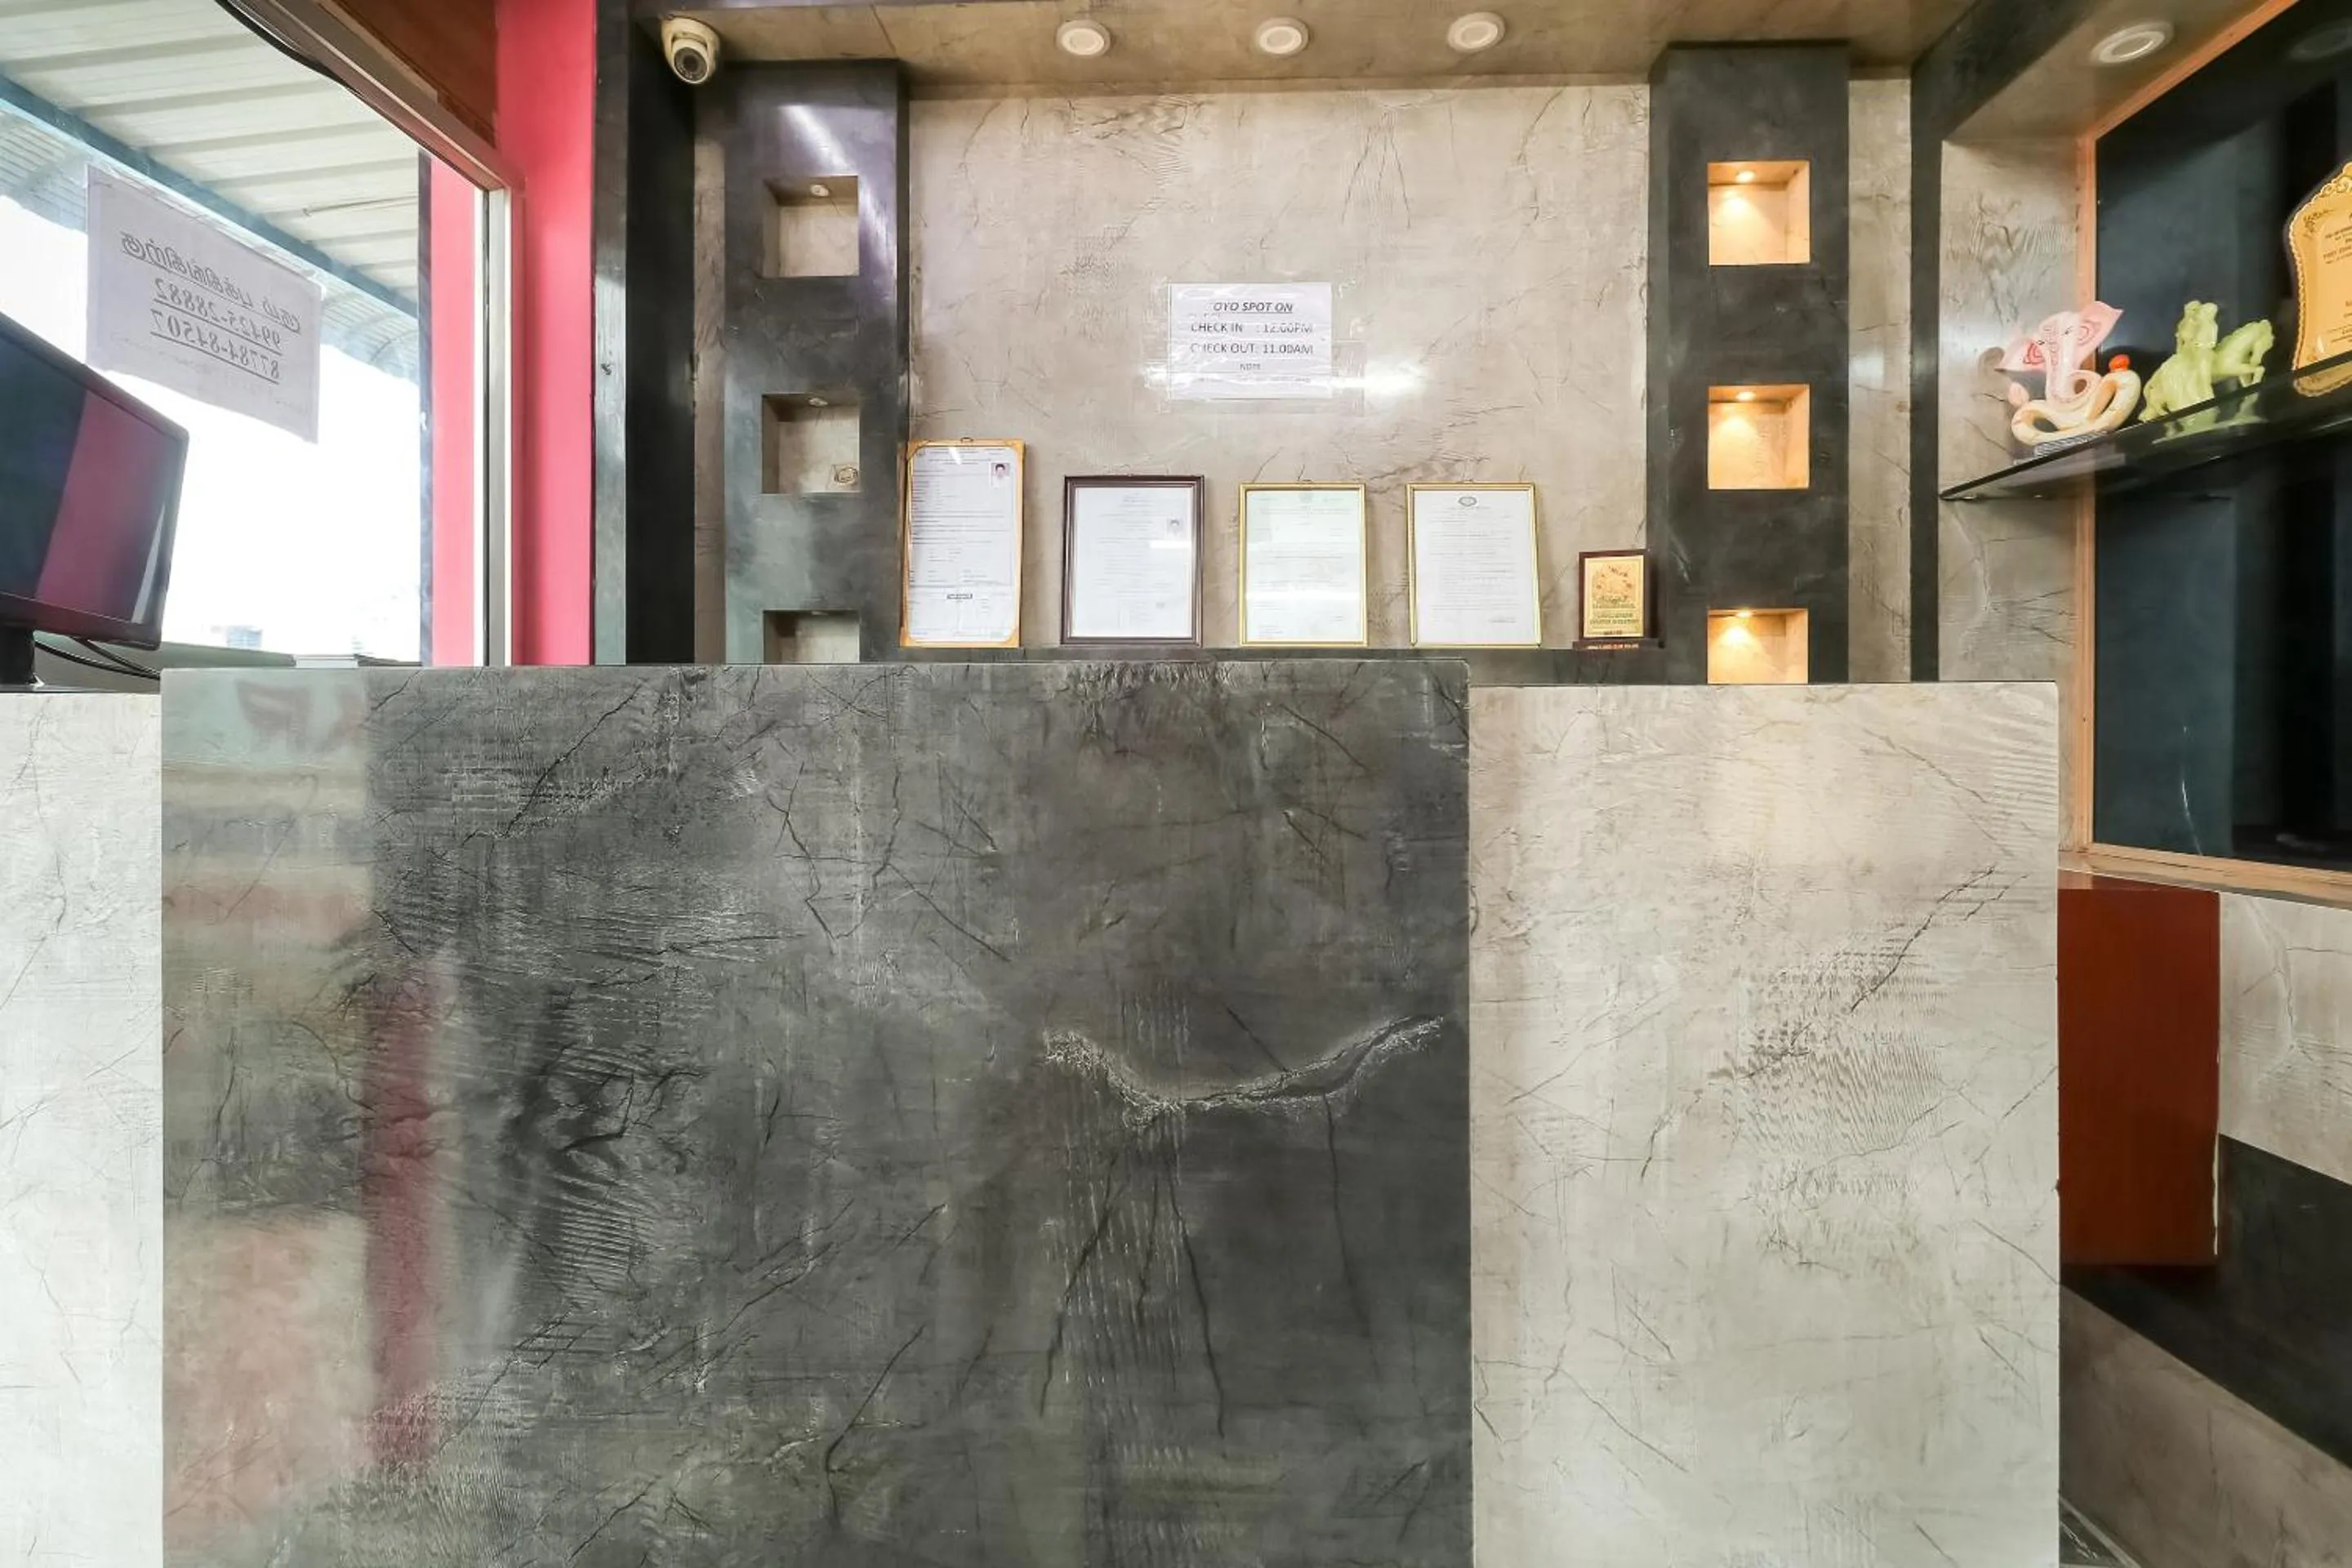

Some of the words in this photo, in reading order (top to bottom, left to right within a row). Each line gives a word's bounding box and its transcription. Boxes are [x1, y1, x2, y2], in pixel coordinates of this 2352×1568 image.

[1214, 302, 1239, 311] OYO
[1242, 302, 1272, 311] SPOT
[1274, 303, 1293, 312] ON
[1191, 323, 1227, 332] CHECK
[1230, 323, 1243, 332] IN
[1190, 343, 1227, 353] CHECK
